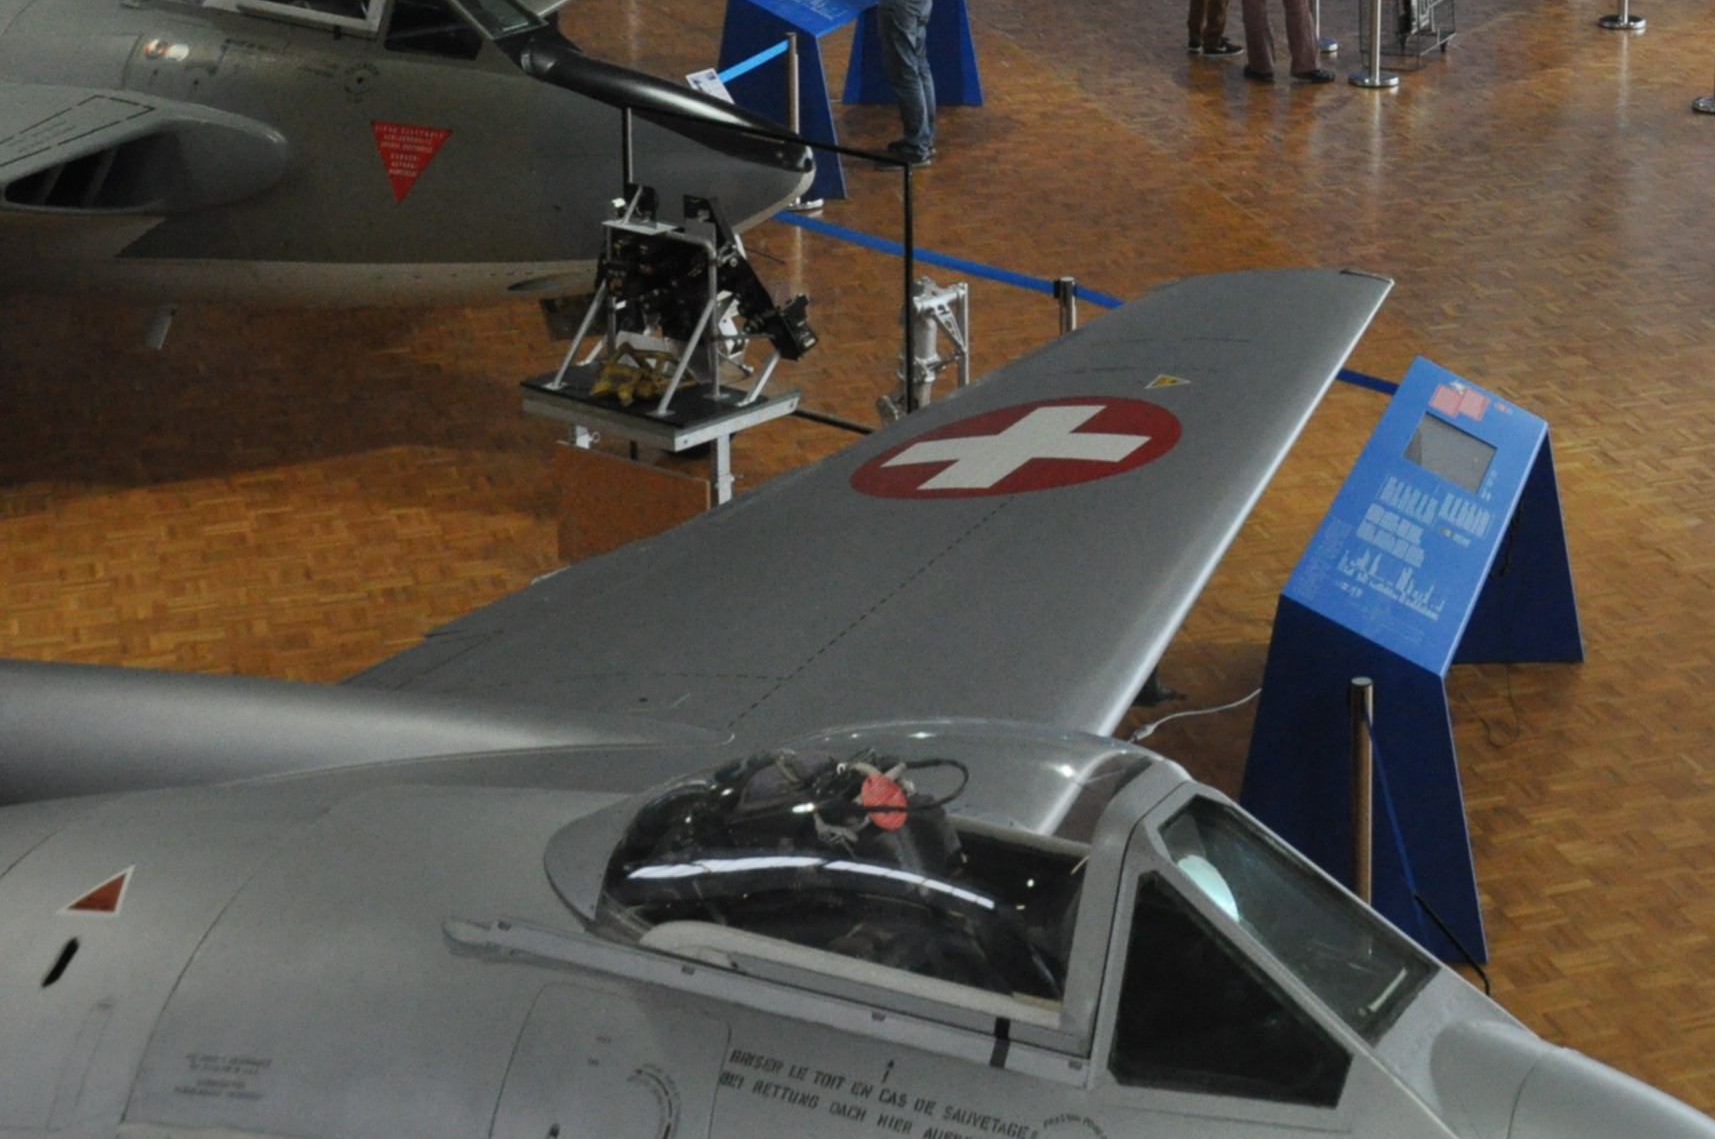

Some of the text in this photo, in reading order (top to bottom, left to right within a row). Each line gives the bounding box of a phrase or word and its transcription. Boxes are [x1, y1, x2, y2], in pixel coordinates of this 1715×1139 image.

[729, 1049, 784, 1072] BRISER
[788, 1064, 809, 1079] LE
[812, 1070, 846, 1090] TOIT
[850, 1081, 874, 1099] EN
[878, 1088, 908, 1108] CAS
[913, 1098, 937, 1116] DE
[752, 1078, 820, 1109] RETTUNG
[829, 1100, 867, 1122] DACH
[877, 1115, 912, 1134] HIER
